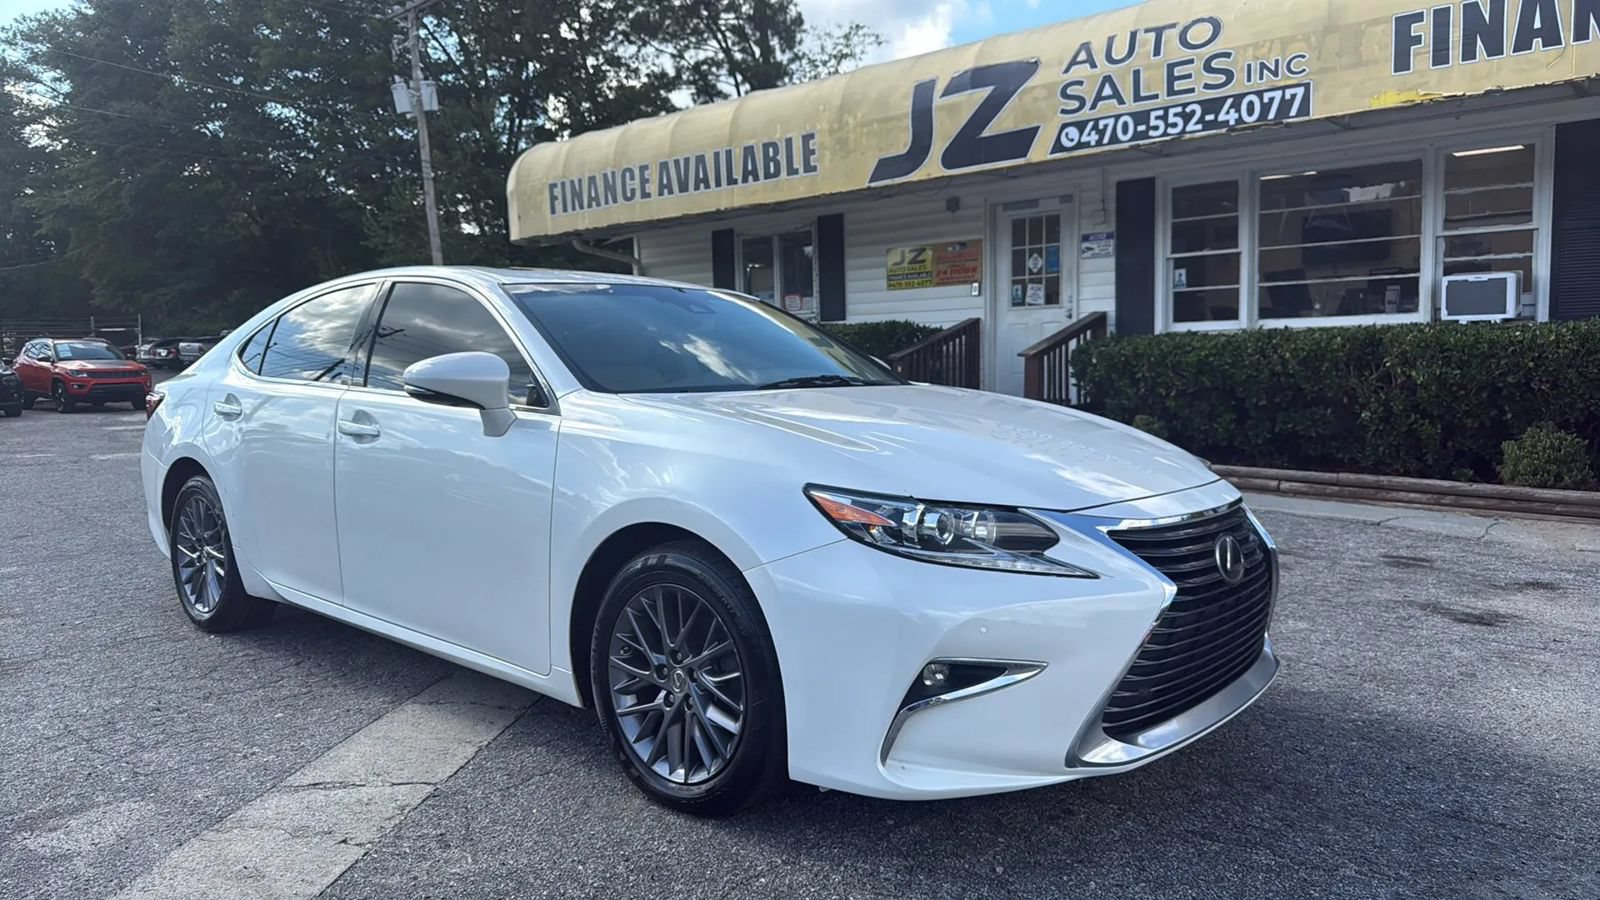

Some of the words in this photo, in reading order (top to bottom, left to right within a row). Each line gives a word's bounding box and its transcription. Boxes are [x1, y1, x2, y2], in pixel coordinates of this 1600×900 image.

[1062, 15, 1223, 75] AUTO
[1057, 50, 1236, 117] SALES
[1245, 52, 1310, 85] INC
[867, 57, 1042, 184] JZ
[1078, 86, 1306, 148] 470-552-4077
[548, 164, 652, 216] FINANCE
[656, 131, 820, 198] AVAILABLE
[891, 247, 927, 267] JZ
